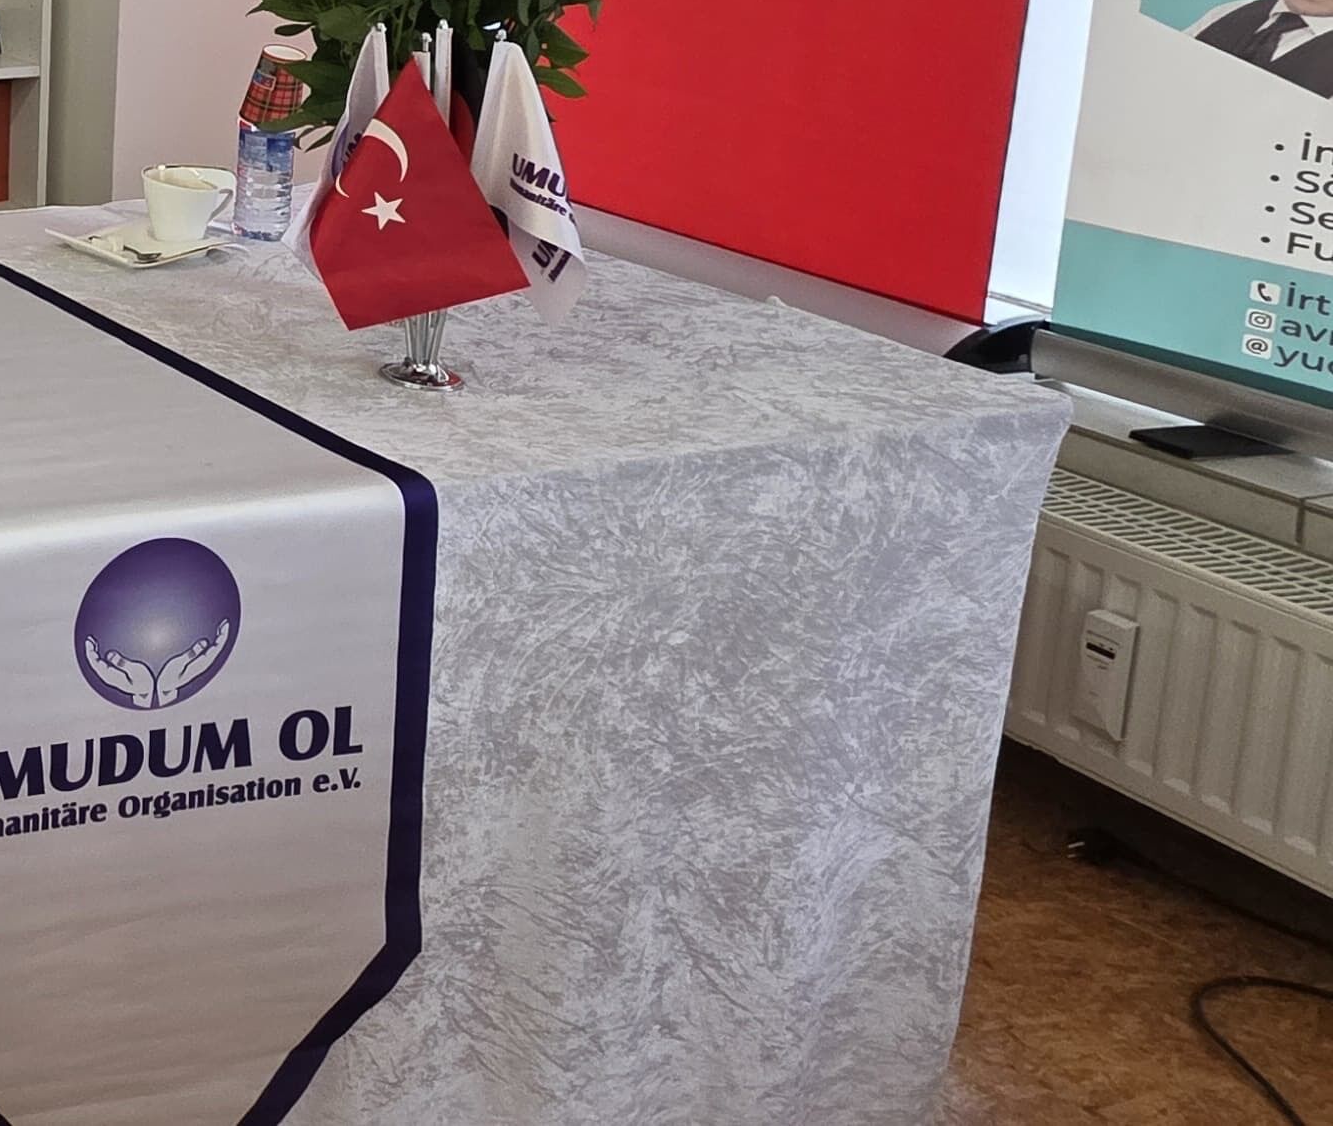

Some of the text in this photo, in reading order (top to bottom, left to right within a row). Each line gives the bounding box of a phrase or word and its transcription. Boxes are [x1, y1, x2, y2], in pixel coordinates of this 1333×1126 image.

[278, 705, 363, 761] OL
[118, 776, 302, 819] Organisation
[312, 767, 361, 793] e.V.
